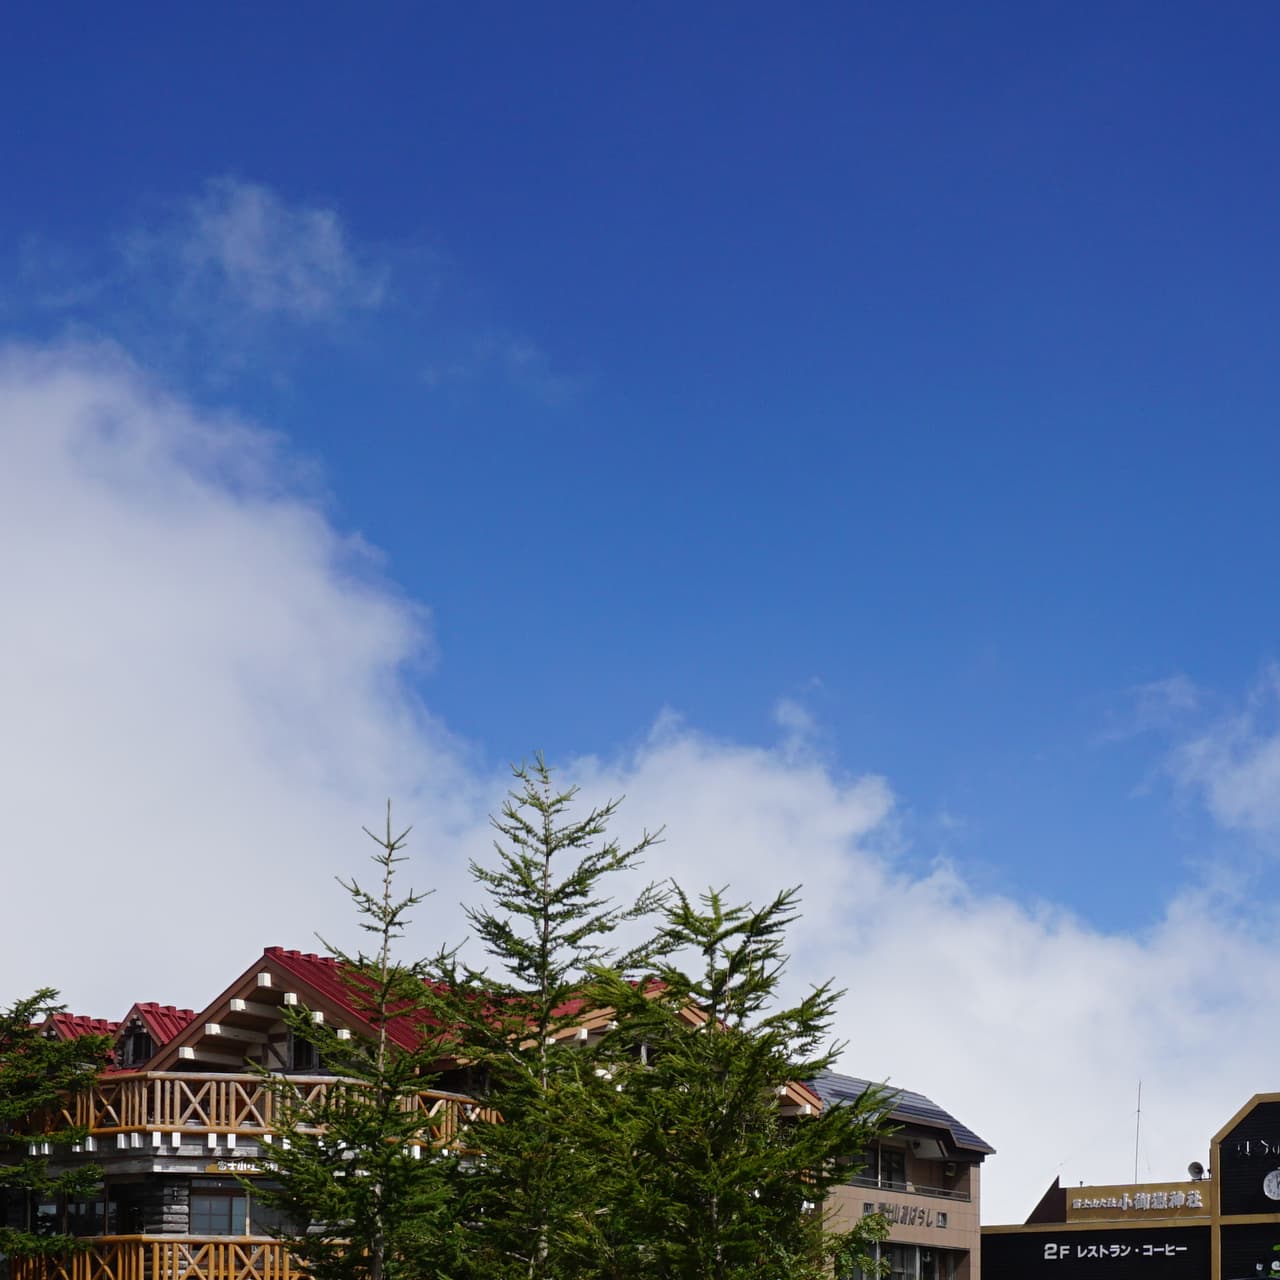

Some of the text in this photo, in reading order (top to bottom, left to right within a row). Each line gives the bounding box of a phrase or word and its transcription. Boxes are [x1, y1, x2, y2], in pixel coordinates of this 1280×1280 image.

[1043, 1243, 1188, 1260] 2F レストラン・コーヒー
